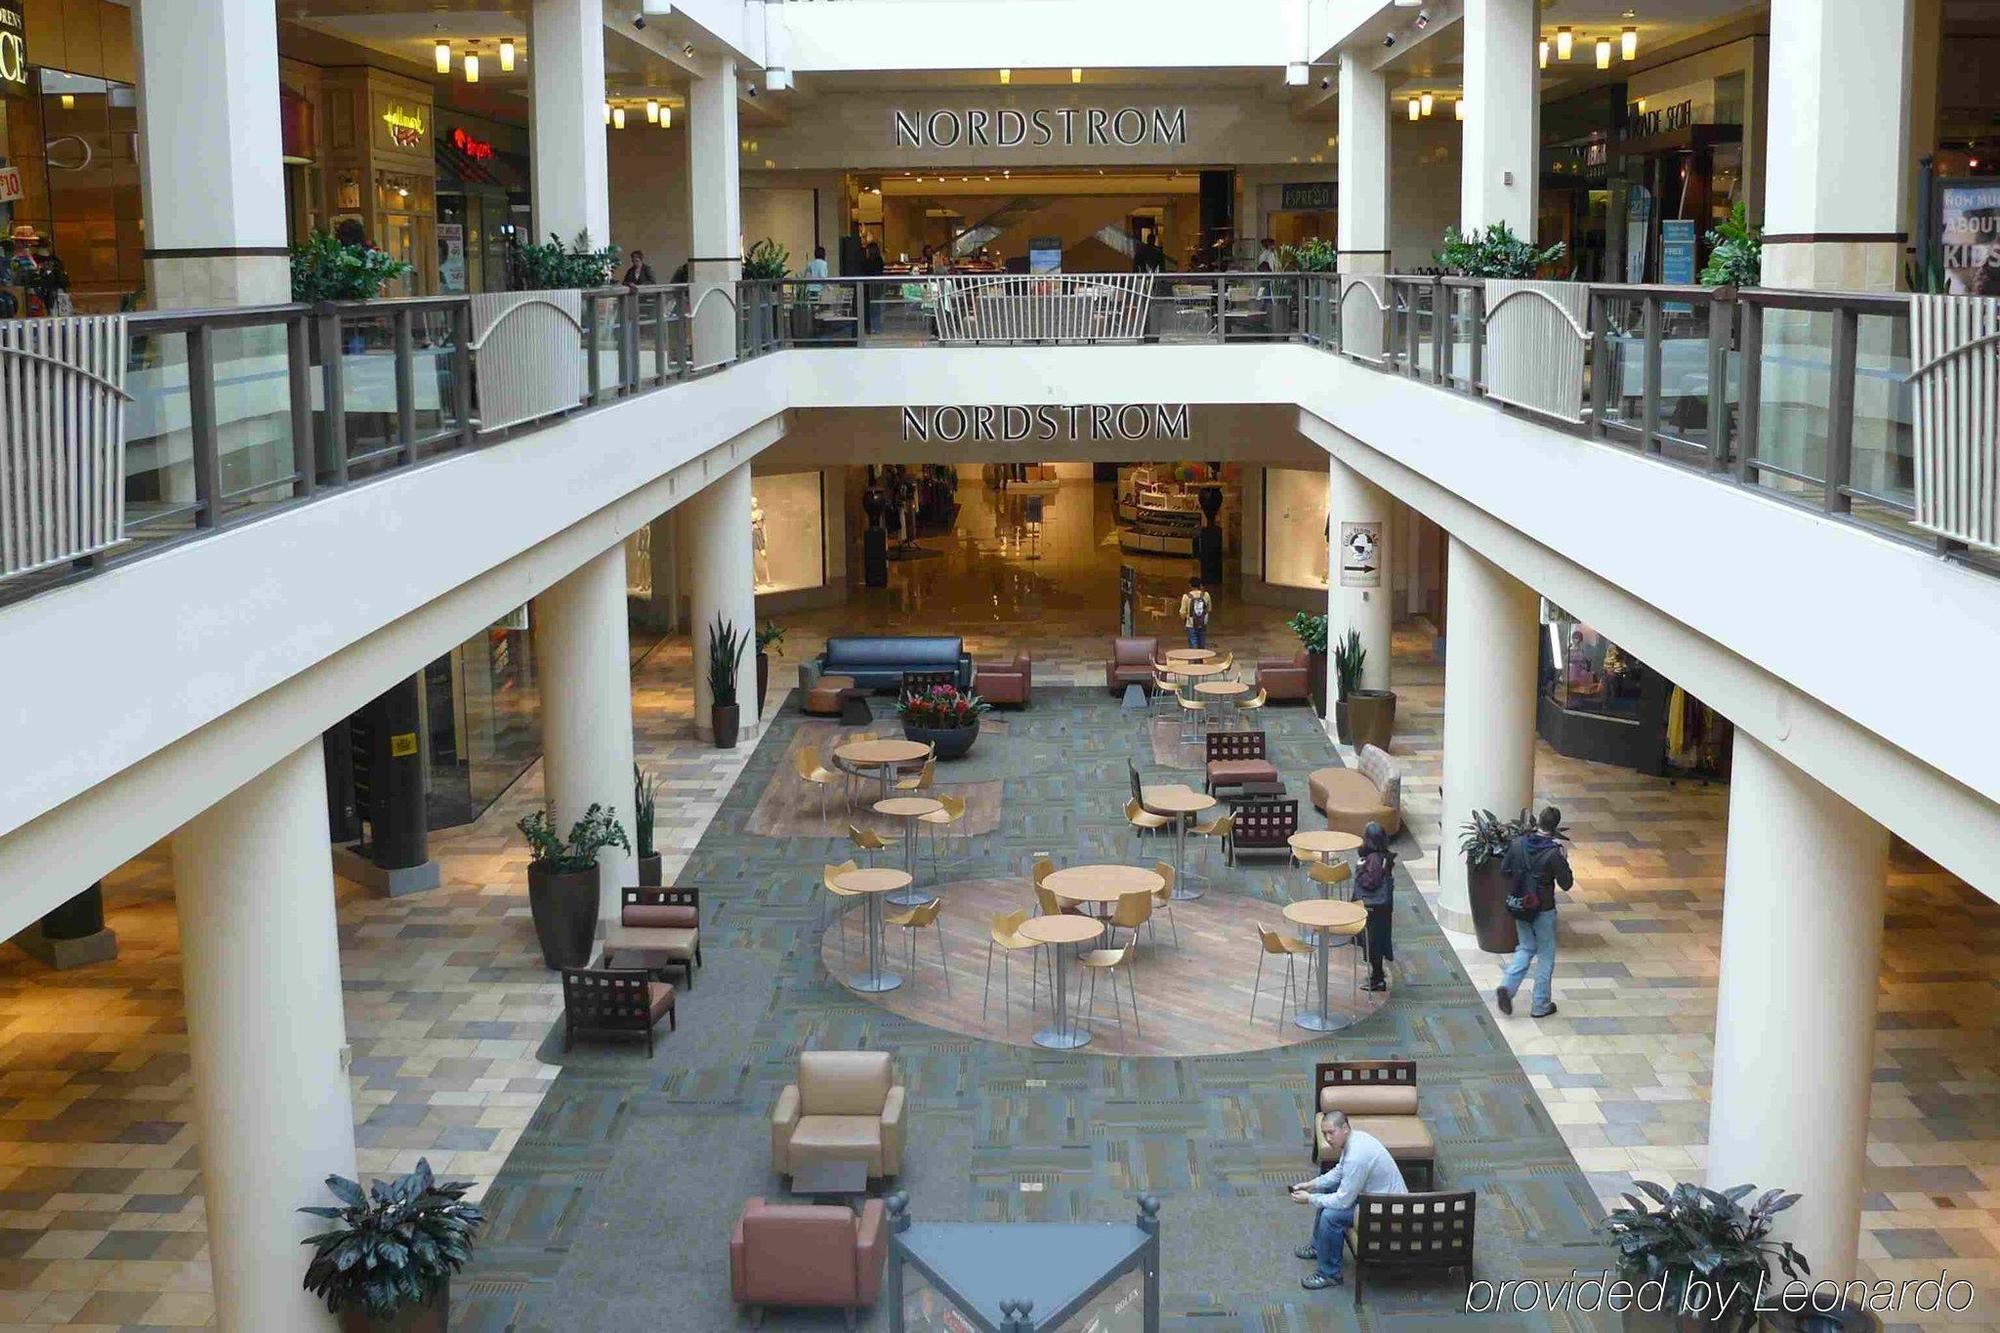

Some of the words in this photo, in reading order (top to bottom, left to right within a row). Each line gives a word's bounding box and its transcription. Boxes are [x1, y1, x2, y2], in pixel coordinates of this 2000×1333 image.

[382, 100, 425, 135] Hallmark
[895, 107, 1187, 147] NORDSTROM
[1944, 216, 2000, 234] ABOUT
[1944, 243, 2000, 268] KIDS
[901, 403, 1190, 441] NORDSTROM
